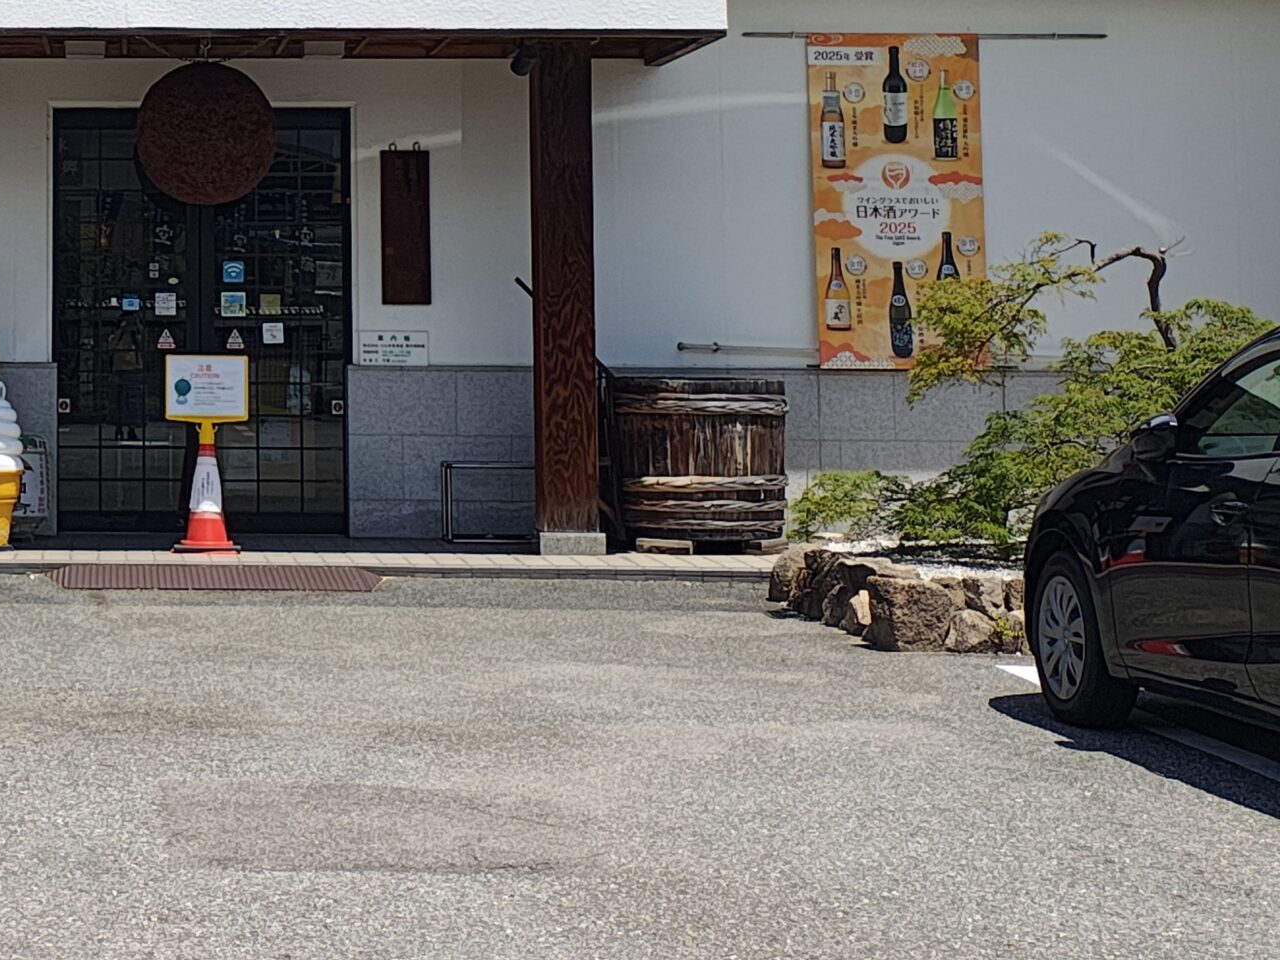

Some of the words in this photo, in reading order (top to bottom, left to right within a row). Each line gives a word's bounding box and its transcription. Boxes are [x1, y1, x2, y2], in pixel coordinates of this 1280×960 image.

[856, 205, 940, 219] 日本酒アワード
[879, 222, 917, 234] 2025
